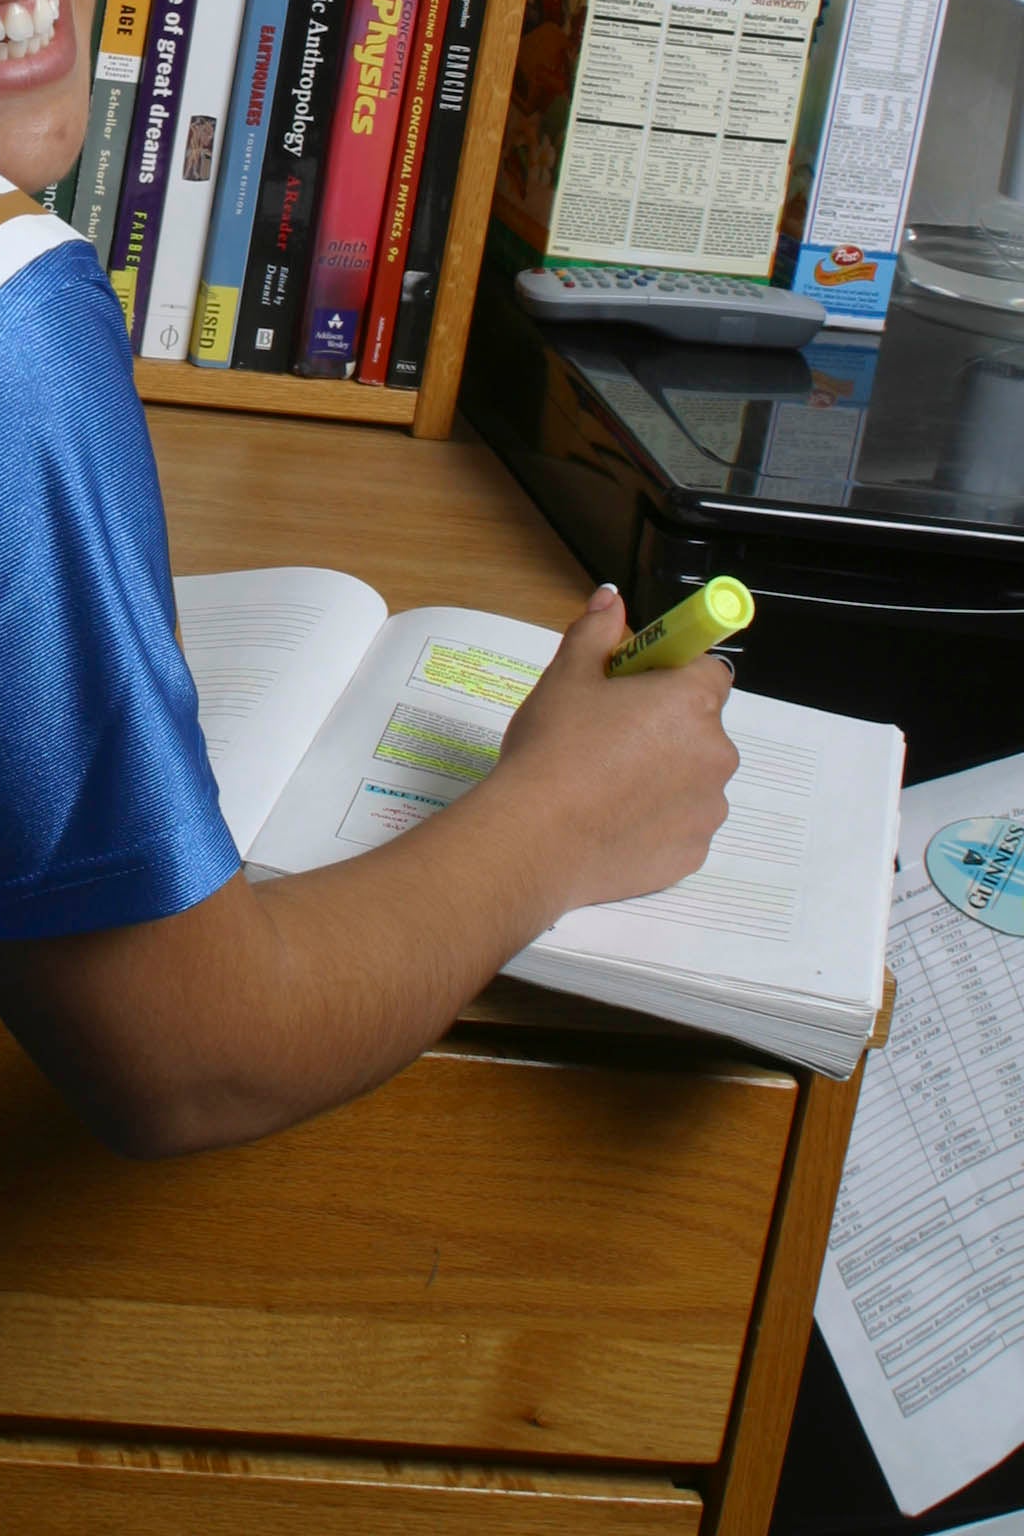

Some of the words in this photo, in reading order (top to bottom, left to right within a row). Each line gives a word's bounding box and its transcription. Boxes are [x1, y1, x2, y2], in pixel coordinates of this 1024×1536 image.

[117, 5, 136, 36] AGE
[163, 12, 184, 36] of
[153, 38, 177, 97] great
[388, 0, 413, 97] CONCEPTUAL
[416, 42, 433, 91] PHYSICS:
[245, 25, 276, 127] EARTHQUAKES
[283, 18, 328, 157] Anthropology
[439, 45, 471, 111] GENOCIDE
[104, 88, 121, 140] Schaller
[400, 96, 423, 179] CONCEPTUAL
[138, 103, 170, 184] dreams
[242, 133, 255, 172] FOURTH
[94, 149, 111, 196] Scharff
[287, 175, 301, 186] A
[87, 205, 101, 241] Schul
[277, 191, 300, 252] Reader
[391, 183, 409, 241] PHYSICS,
[319, 254, 370, 269] edition
[328, 240, 368, 253] ninth
[835, 248, 860, 263] Post
[277, 266, 289, 293] Edited
[199, 302, 221, 349] USED
[315, 331, 344, 340] Addison
[967, 824, 1024, 910] GUINNESS
